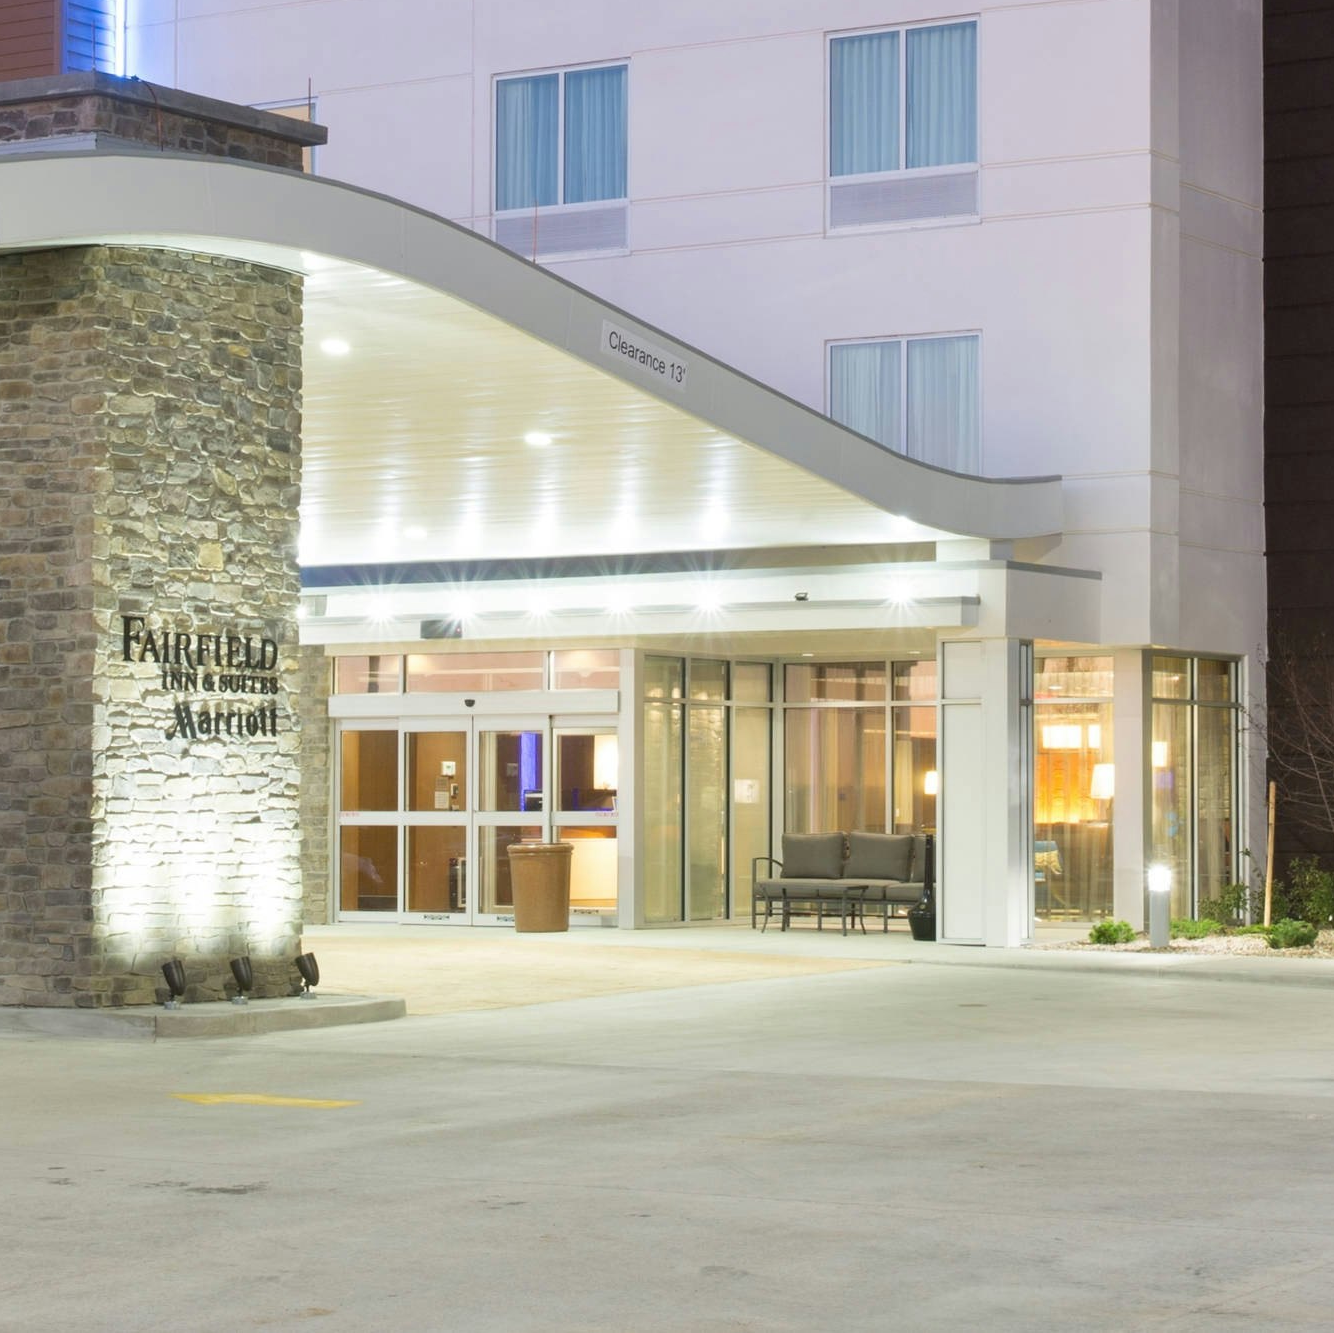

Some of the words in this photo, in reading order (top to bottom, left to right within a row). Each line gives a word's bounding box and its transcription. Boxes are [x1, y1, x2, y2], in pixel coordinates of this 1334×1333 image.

[609, 331, 665, 374] Clearance
[120, 615, 278, 671] FAIRFIELD
[161, 670, 198, 692] INN
[201, 674, 216, 692] &
[218, 674, 279, 695] SUITES
[165, 702, 278, 740] Marriott
